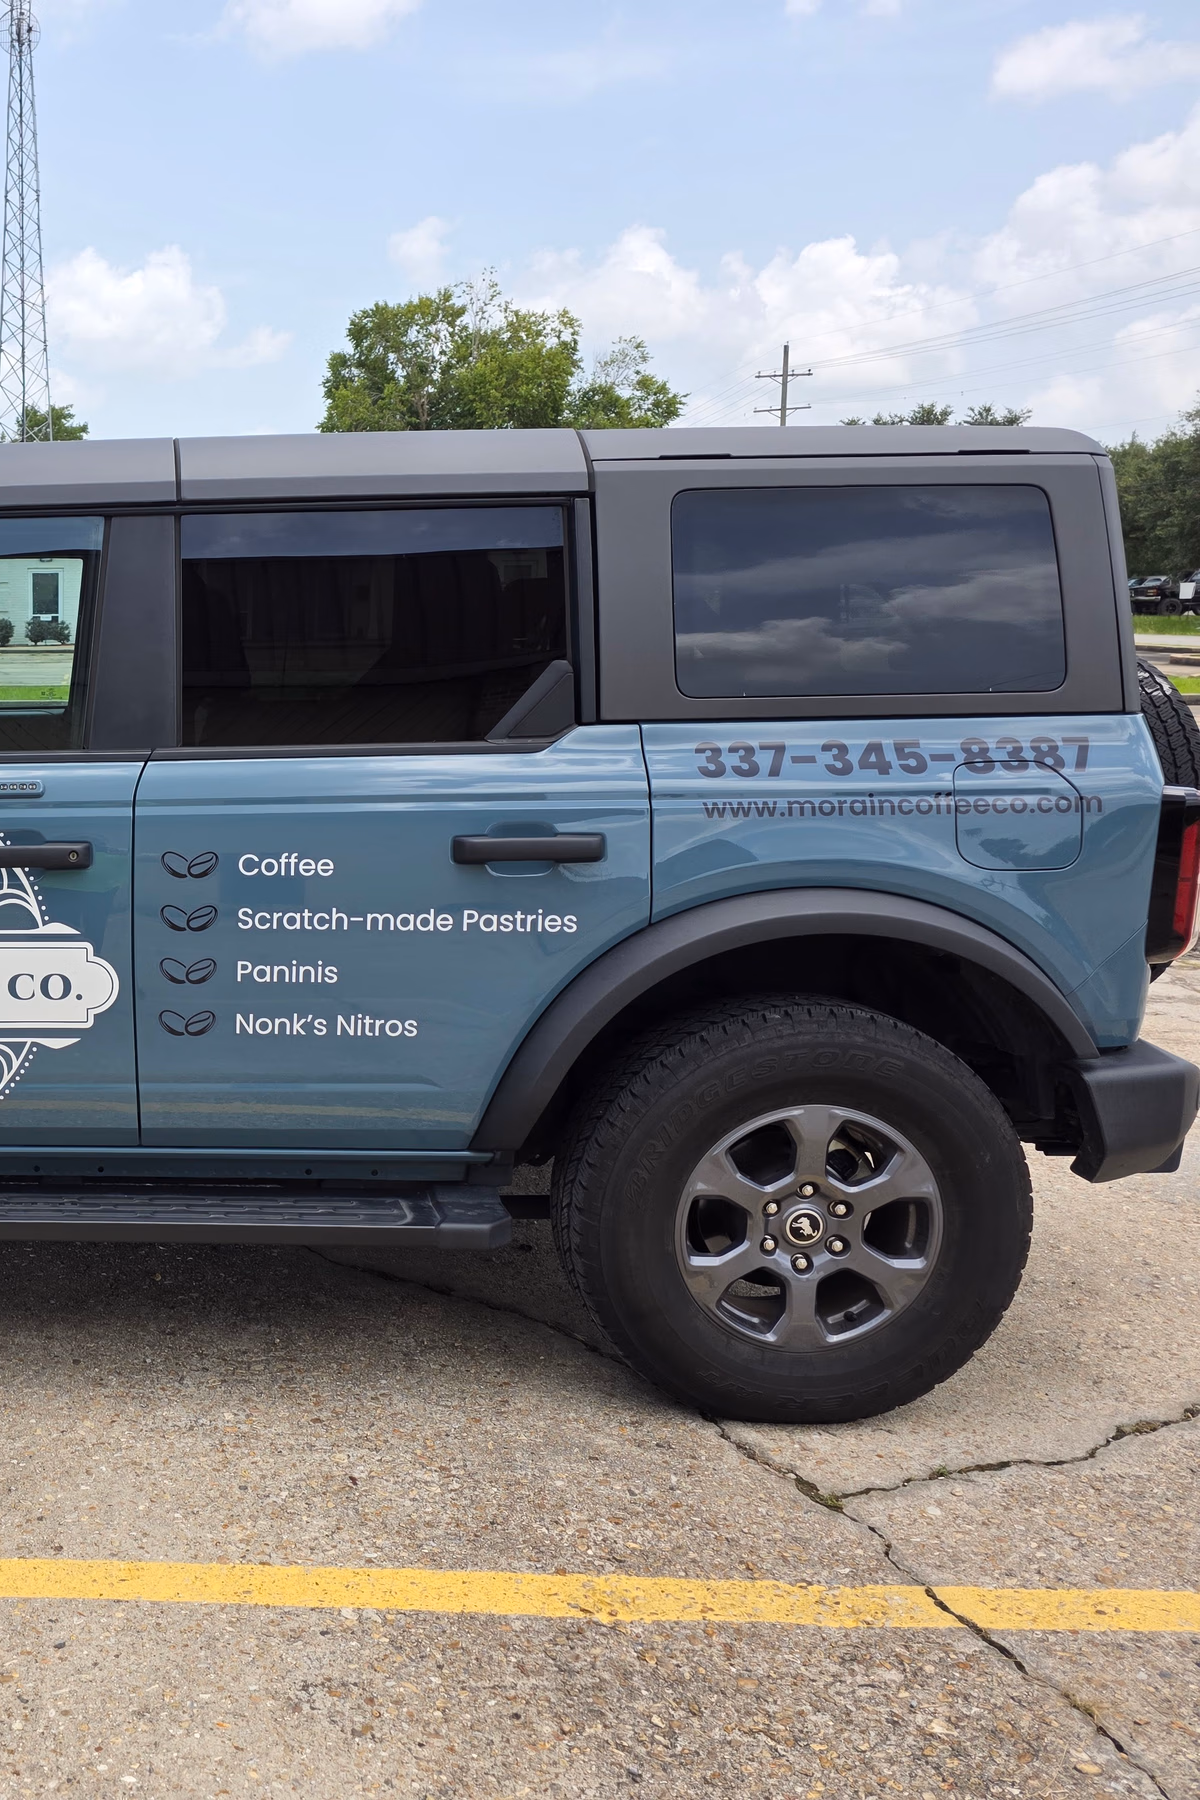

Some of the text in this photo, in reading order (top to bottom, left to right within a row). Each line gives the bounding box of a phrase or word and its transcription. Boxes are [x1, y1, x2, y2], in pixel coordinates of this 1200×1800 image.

[693, 736, 1090, 778] 337-345-8387
[702, 791, 1103, 820] www.moraincoffeeco.com
[238, 852, 334, 877] Coffee
[237, 907, 578, 933] Scratch-made Pastries
[237, 959, 338, 984] Paninis
[6, 973, 84, 1002] CO.
[336, 1013, 418, 1037] Nitros
